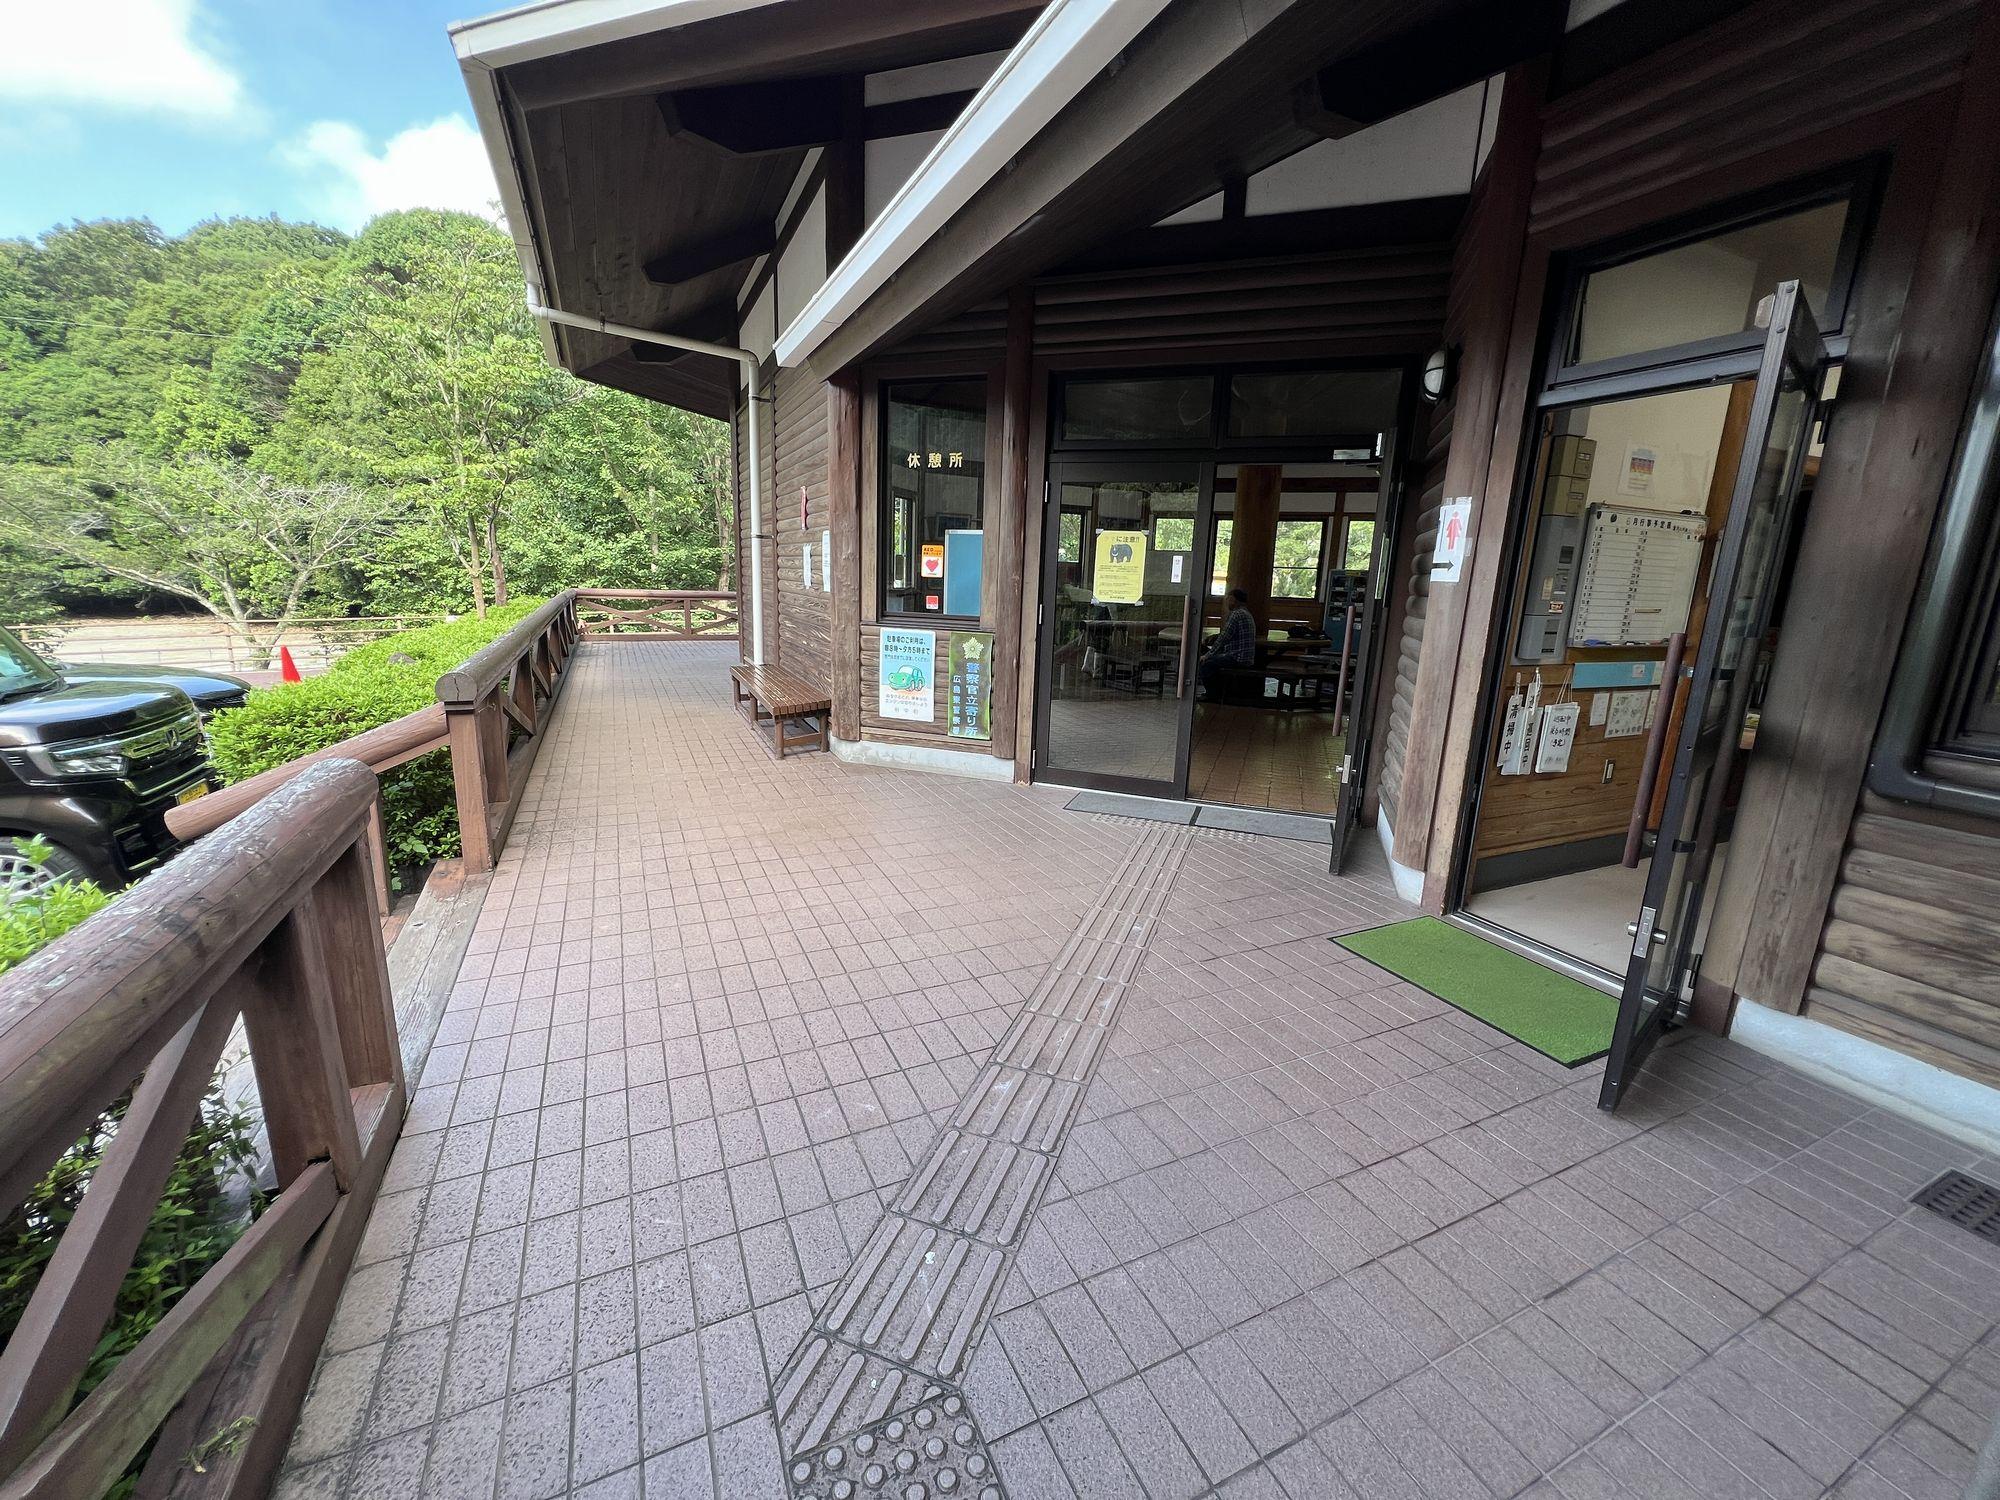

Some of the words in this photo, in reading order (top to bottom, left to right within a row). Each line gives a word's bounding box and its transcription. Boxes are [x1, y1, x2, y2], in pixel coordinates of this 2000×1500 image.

[907, 452, 963, 469] 休憩所
[965, 662, 979, 736] 警察官立寄り所
